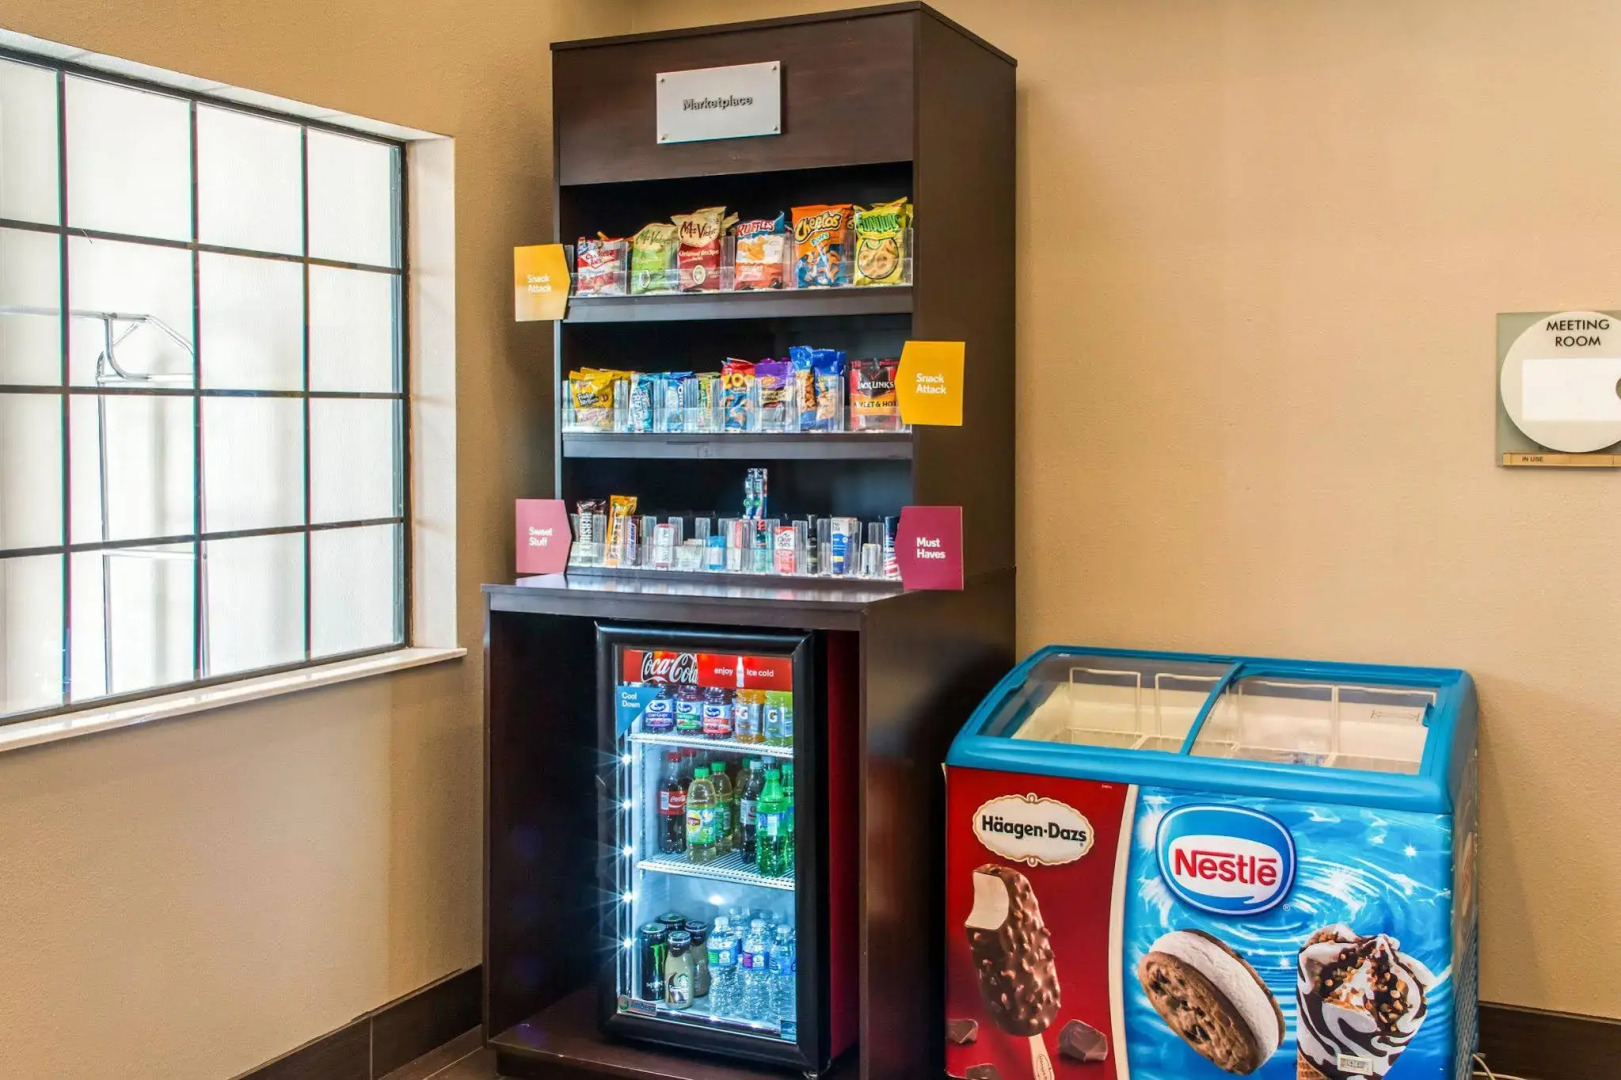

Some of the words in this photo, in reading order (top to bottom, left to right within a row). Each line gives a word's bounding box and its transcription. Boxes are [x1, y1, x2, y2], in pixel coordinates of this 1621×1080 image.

[683, 95, 753, 110] Marketplace
[736, 220, 775, 237] RUFFLES
[795, 210, 842, 243] Cheetos
[527, 273, 550, 284] Snack
[528, 283, 552, 294] Attack
[1546, 319, 1610, 331] MEETING
[1555, 335, 1601, 347] ROOM
[916, 372, 944, 383] Snack
[916, 384, 947, 394] Attack
[529, 526, 553, 536] Sweet
[529, 537, 548, 547] Stuff
[916, 537, 940, 547] Must
[916, 548, 946, 559] Haves
[641, 651, 698, 684] Coca-Cola
[714, 667, 733, 676] enjoy
[621, 691, 638, 700] Cool
[621, 700, 641, 708] Down
[768, 709, 778, 723] G
[982, 815, 1087, 842] Häagen-Dazs
[1175, 848, 1277, 886] Nestlé
